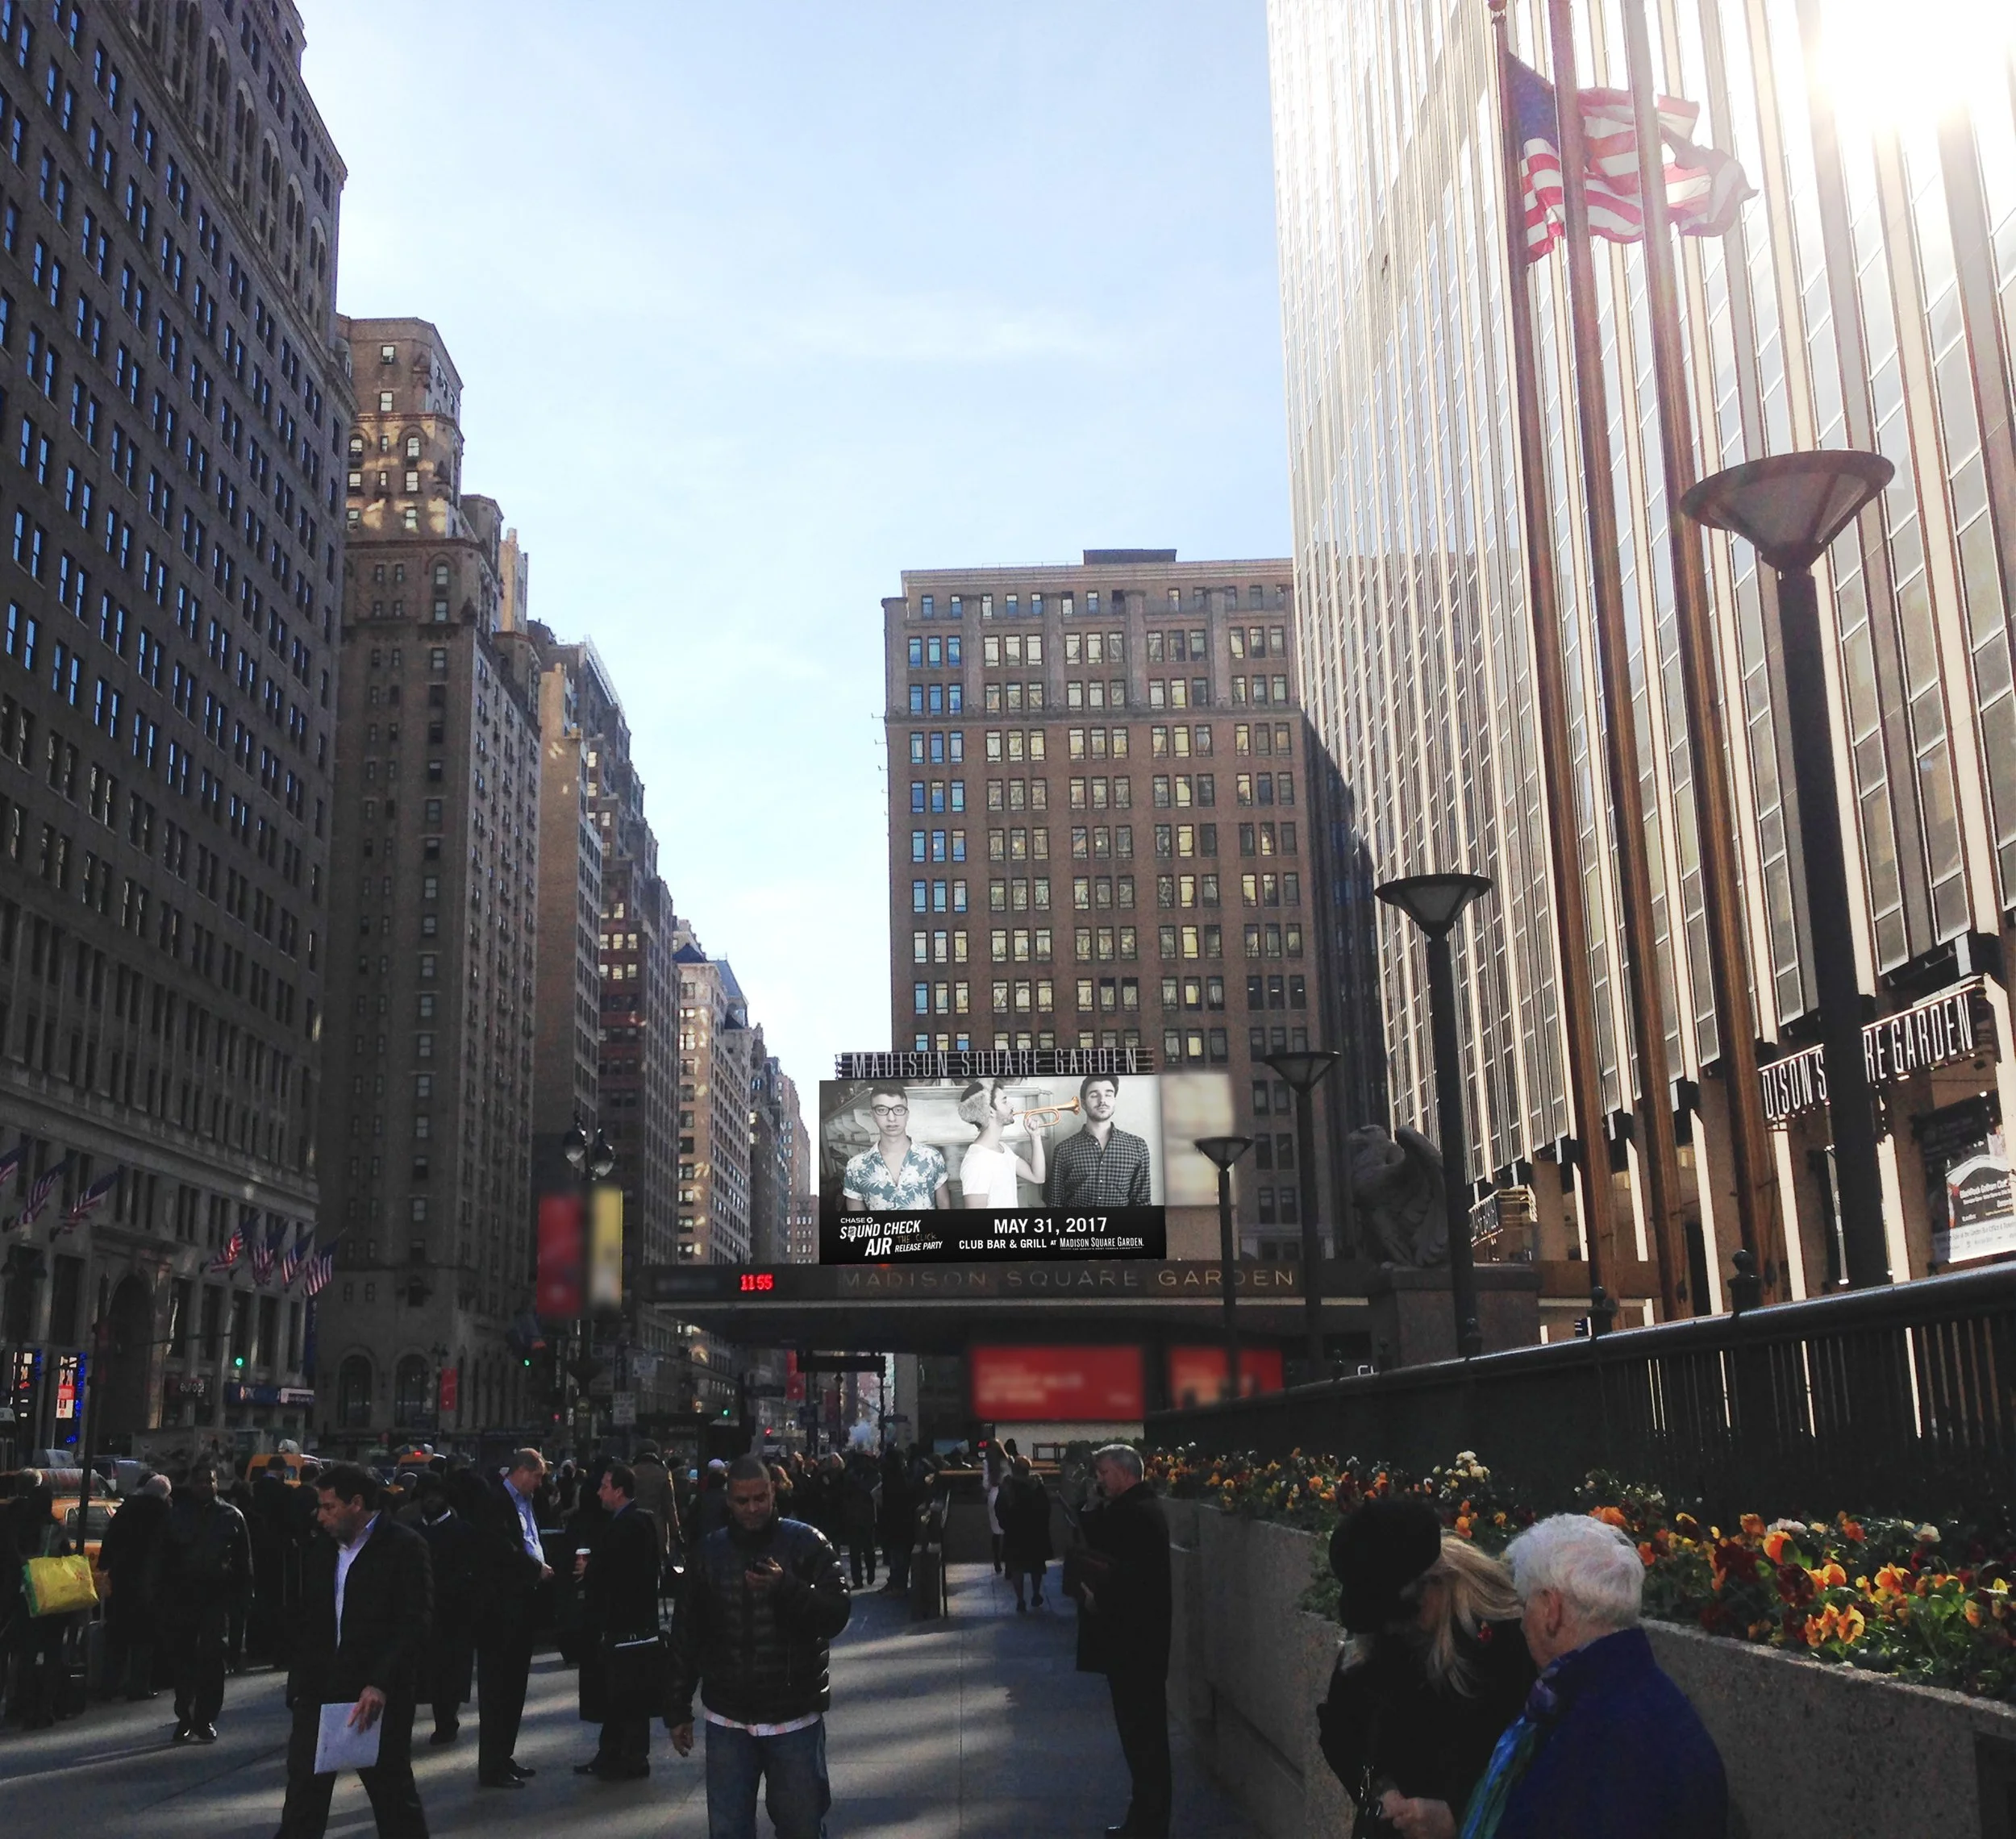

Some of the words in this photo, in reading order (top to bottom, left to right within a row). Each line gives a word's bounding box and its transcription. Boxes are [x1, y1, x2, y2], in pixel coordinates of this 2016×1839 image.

[852, 1051, 948, 1079] MADISON
[961, 1049, 1041, 1077] SQUARE
[1054, 1047, 1137, 1075] GARDEN
[1761, 1054, 1814, 1119] DISON
[1891, 992, 1973, 1074] GARDEN
[839, 1223, 881, 1242] SOUND
[884, 1220, 922, 1236] CHECK
[993, 1218, 1028, 1234] MAY
[1033, 1218, 1060, 1235] 31,
[1065, 1217, 1107, 1233] 2017
[864, 1237, 893, 1257] AJR
[894, 1243, 922, 1253] RELEASE
[923, 1241, 943, 1250] PARTY
[959, 1239, 984, 1250] CLUB
[986, 1239, 1006, 1249] BAR
[1009, 1239, 1018, 1249] &
[1020, 1238, 1047, 1249] GRILL
[1060, 1238, 1089, 1248] MADISON
[1090, 1237, 1115, 1248] SQUARE
[845, 1270, 986, 1288] MADISON
[1006, 1270, 1139, 1288] SQUARE
[1157, 1269, 1294, 1286] GARDEN
